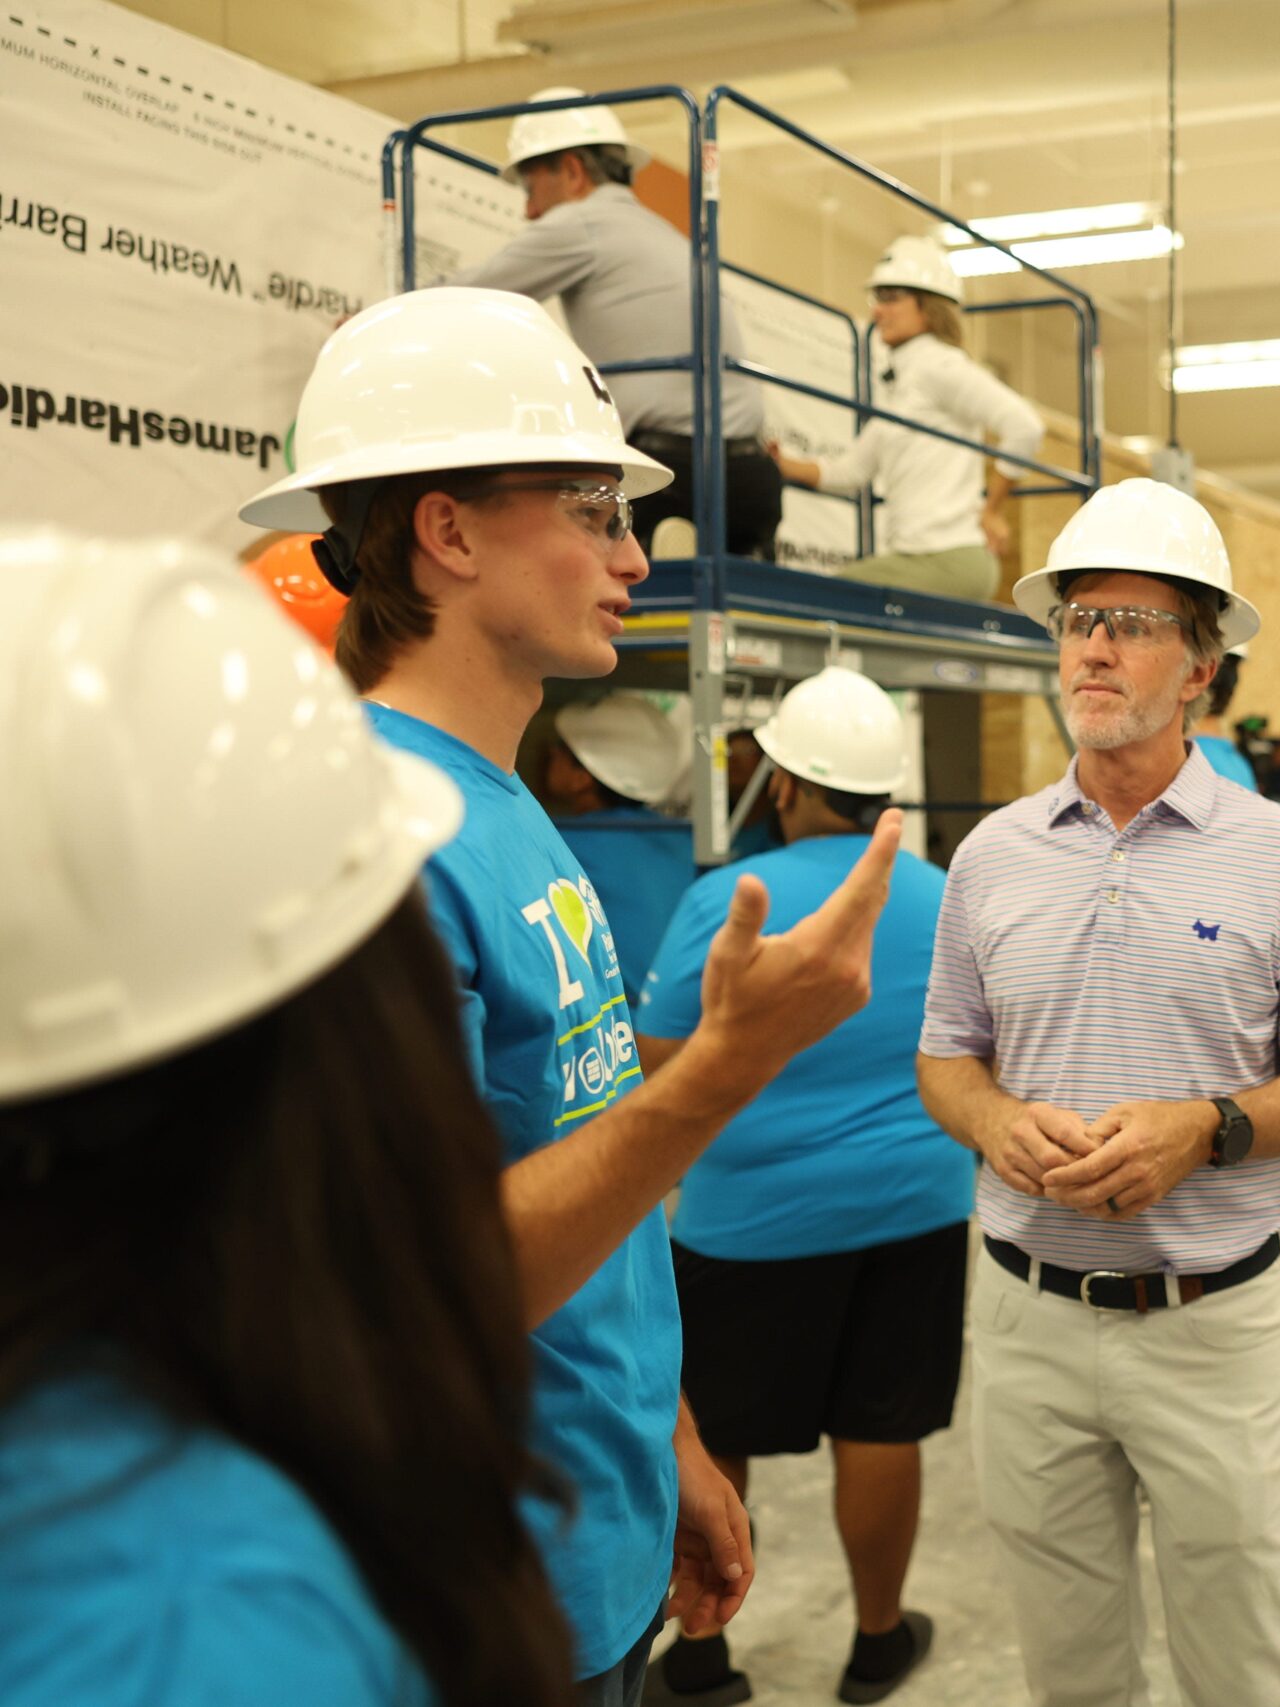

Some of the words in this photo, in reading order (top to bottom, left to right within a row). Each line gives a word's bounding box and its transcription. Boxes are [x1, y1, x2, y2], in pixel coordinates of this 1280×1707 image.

[39, 53, 122, 95] HORIZONTAL
[124, 85, 179, 114] OVERLAP
[82, 90, 132, 118] INSTALL
[135, 110, 181, 135] FACING
[102, 225, 242, 296] Weather
